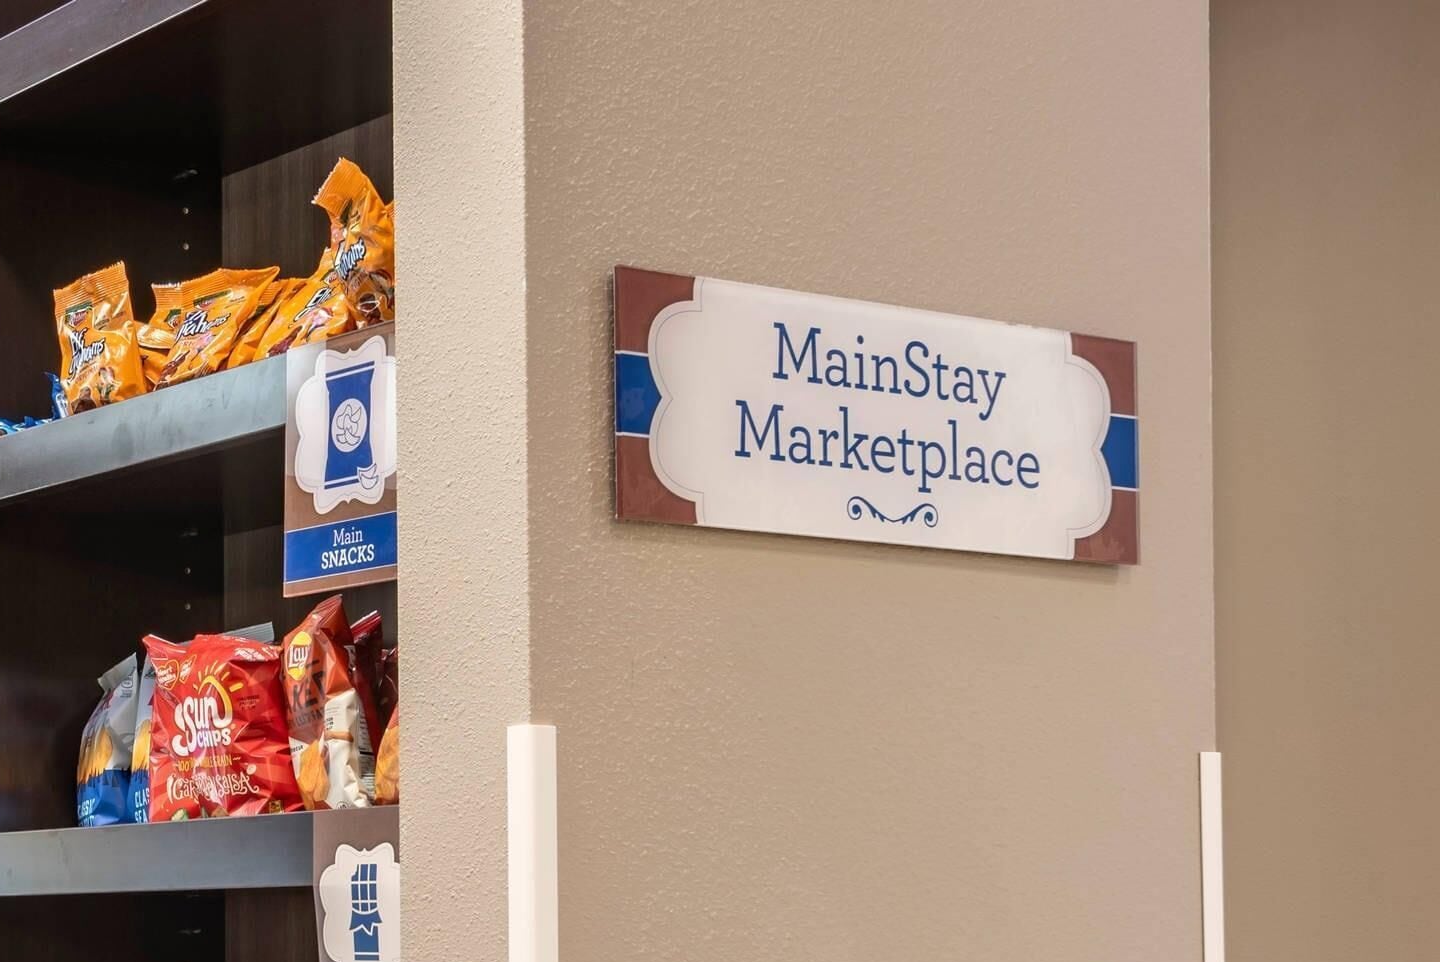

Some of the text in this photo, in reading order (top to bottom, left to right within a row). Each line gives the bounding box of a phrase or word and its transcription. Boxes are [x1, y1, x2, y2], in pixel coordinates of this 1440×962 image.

[772, 322, 1006, 420] MainStay
[734, 399, 1040, 493] Marketplace
[333, 526, 363, 547] Main
[321, 543, 375, 570] SNACKS
[195, 729, 231, 748] CHIPS
